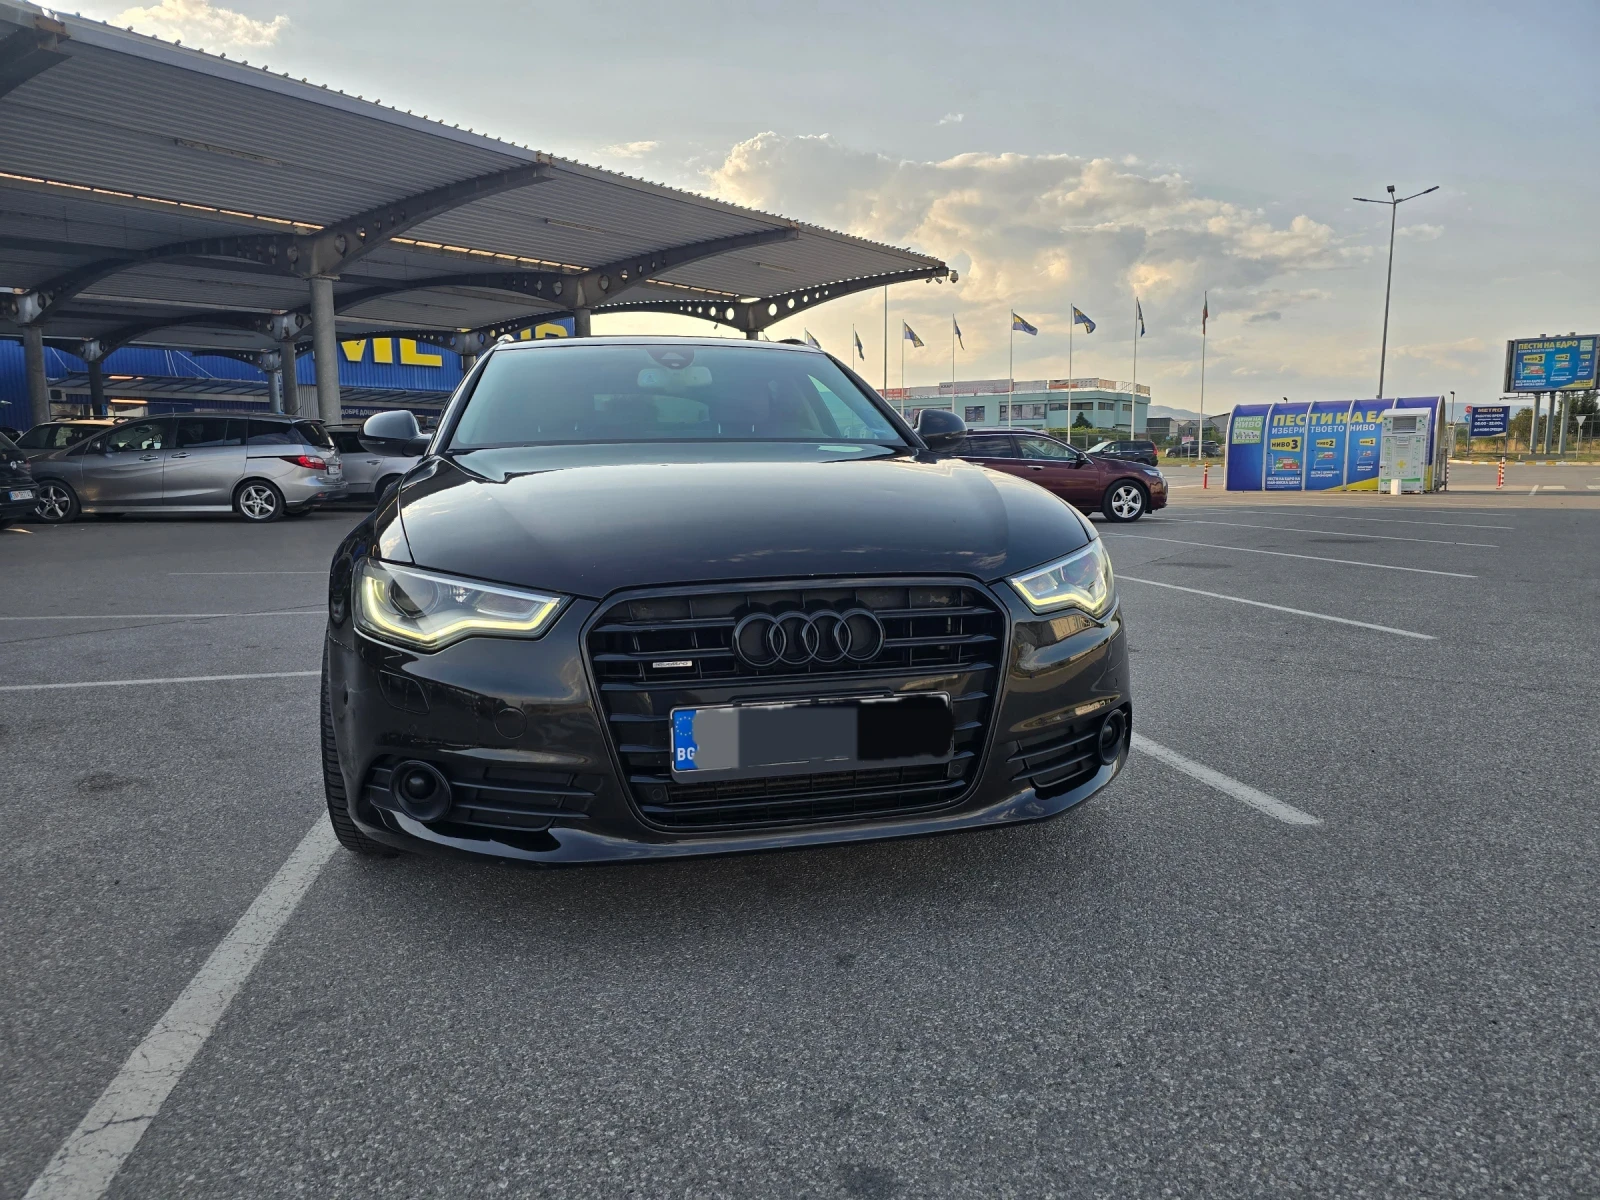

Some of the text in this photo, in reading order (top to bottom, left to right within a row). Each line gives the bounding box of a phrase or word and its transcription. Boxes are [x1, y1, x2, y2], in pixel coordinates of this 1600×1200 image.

[1556, 340, 1578, 348] ЕДРО
[1273, 413, 1333, 427] ПЕСТИ
[1336, 411, 1363, 424] НА
[1235, 421, 1261, 429] НИВО
[1310, 425, 1344, 433] ТВОЕТО
[1291, 439, 1298, 449] 3
[677, 747, 695, 761] BG
